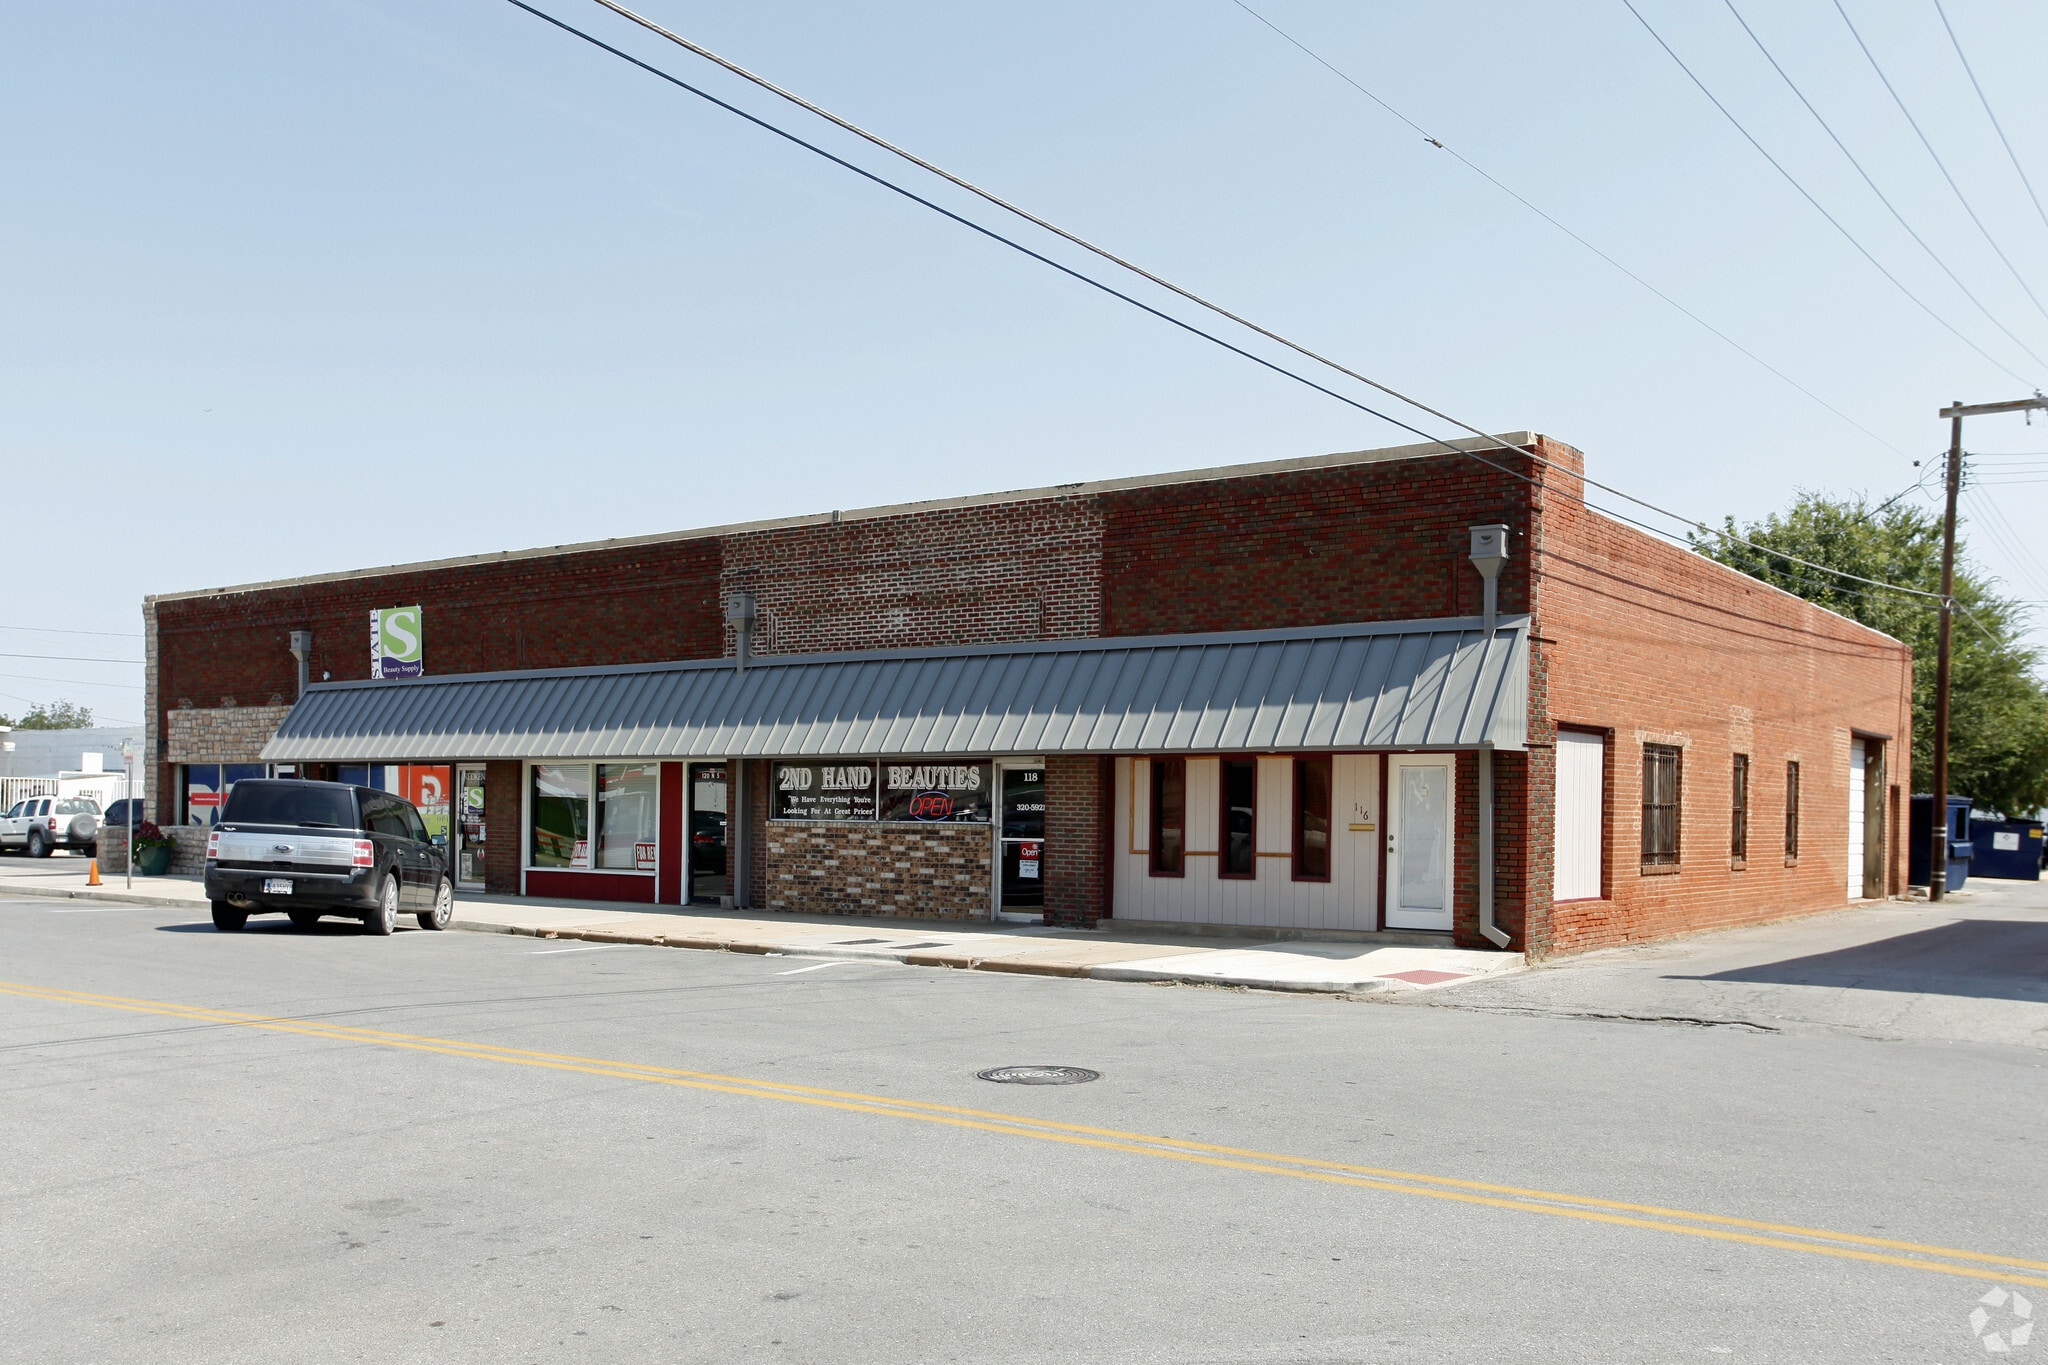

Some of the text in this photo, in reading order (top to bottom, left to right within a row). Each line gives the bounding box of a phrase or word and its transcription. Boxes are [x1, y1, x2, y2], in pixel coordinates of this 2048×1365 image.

[383, 611, 417, 658] S
[370, 610, 379, 678] STATE
[383, 664, 419, 674] Beauty Supply
[779, 765, 980, 790] 2ND HAND BEAUTIES
[1023, 772, 1038, 782] 118
[820, 795, 850, 805] Everything
[909, 797, 954, 816] OPEN
[783, 807, 807, 816] Looking
[1355, 802, 1369, 820] 116
[636, 846, 646, 860] FOR
[1021, 848, 1038, 857] Open
